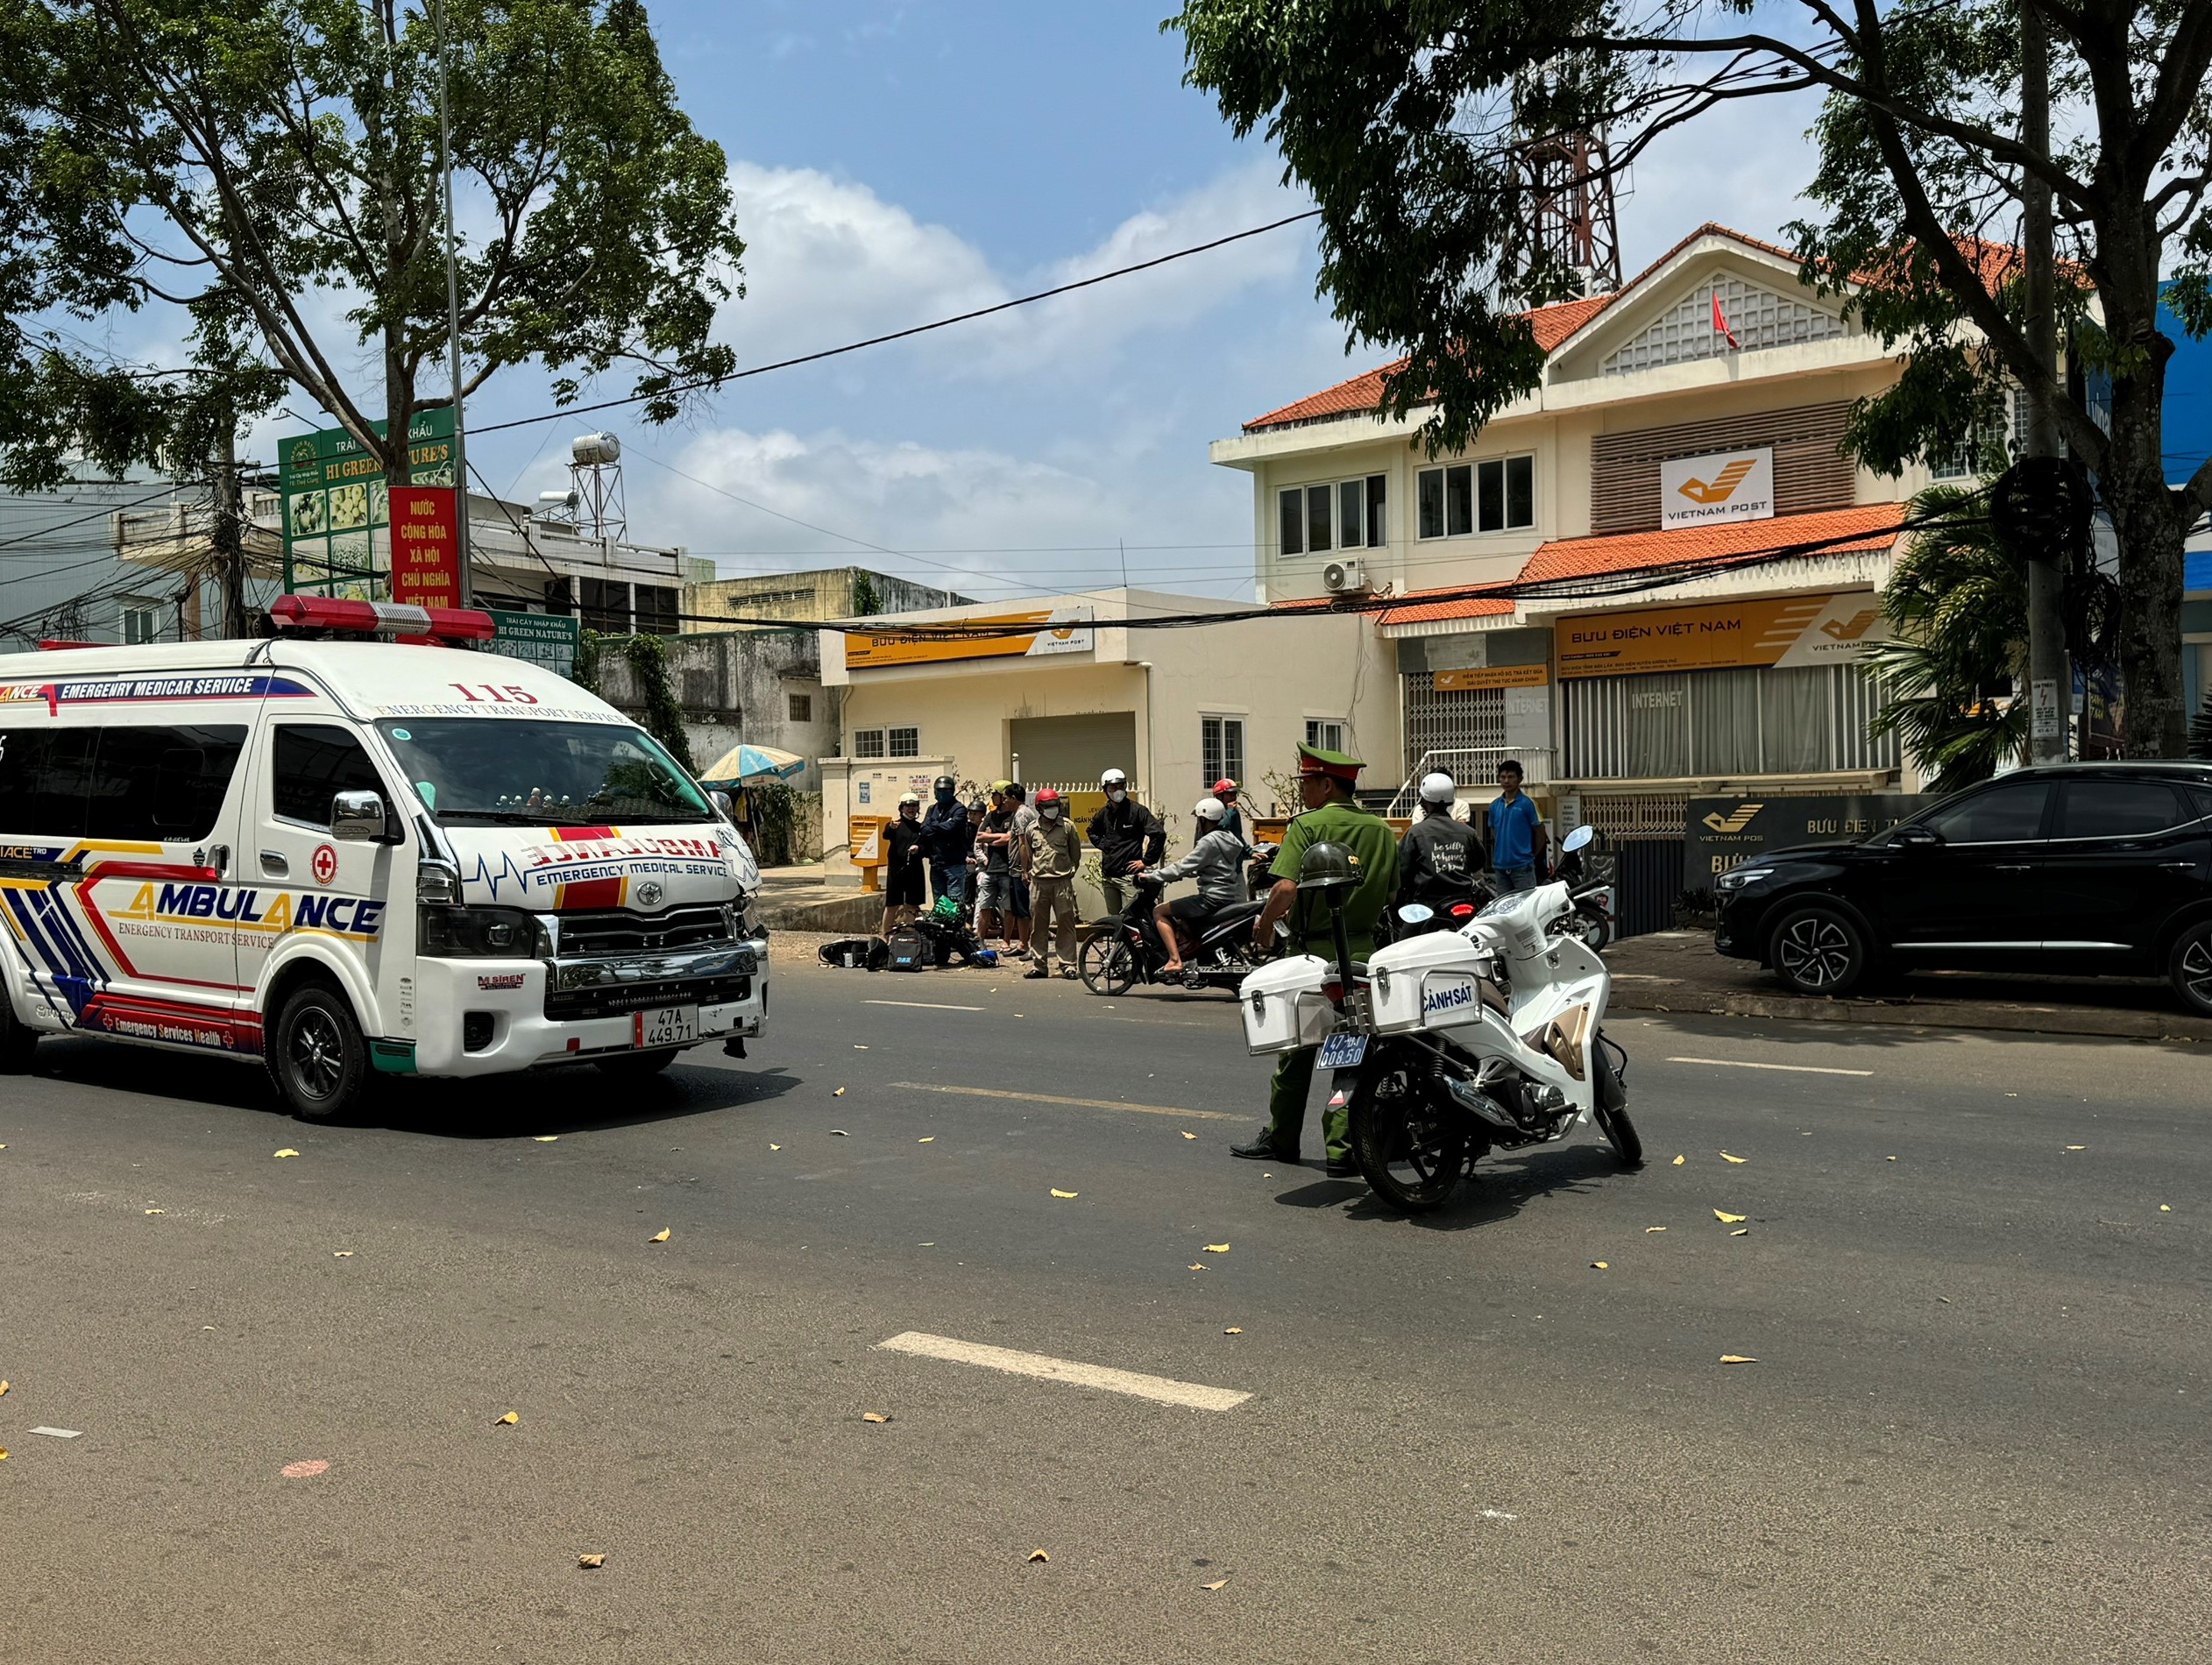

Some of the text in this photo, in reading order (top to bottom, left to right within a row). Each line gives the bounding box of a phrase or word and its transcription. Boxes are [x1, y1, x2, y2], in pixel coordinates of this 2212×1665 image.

[336, 436, 356, 452] TRÁI
[325, 464, 340, 480] HI
[408, 444, 449, 465] URE'S
[410, 499, 436, 515] NƯỚC
[1668, 501, 1768, 521] VIETNAM POST
[401, 522, 447, 542] CỘNG HÒA
[410, 546, 440, 565] XÃ HỘI
[401, 568, 450, 587] CHỦ NGHĨA
[428, 596, 448, 608] NAM
[499, 626, 573, 641] HI GREEN NATURE'S
[1571, 619, 1741, 643] BƯU ĐIỆN VIỆT NAM
[1812, 642, 1860, 651] VIETNAM
[0, 685, 43, 702] ANCE
[133, 680, 194, 697] MEDICAR
[194, 677, 254, 695] SERVICE
[448, 684, 538, 705] 115
[1632, 691, 1683, 709] INTERNET
[479, 705, 568, 718] TRANSPORT
[568, 710, 627, 724] SERVICE
[1807, 818, 1838, 833] BƯU
[0, 847, 32, 859] IACE
[536, 862, 727, 886] EMERGENCY MEDICAL SERVICE
[128, 882, 386, 934] AMBULANCE
[174, 927, 230, 945] TRANSPORT
[231, 932, 275, 949] SERVICE
[1423, 981, 1472, 1012] CẢNH SÁT
[658, 1009, 683, 1025] 47A
[115, 1017, 221, 1046] Emergency Services Health
[649, 1024, 691, 1045] 449.71
[1321, 1048, 1361, 1067] 008.50
